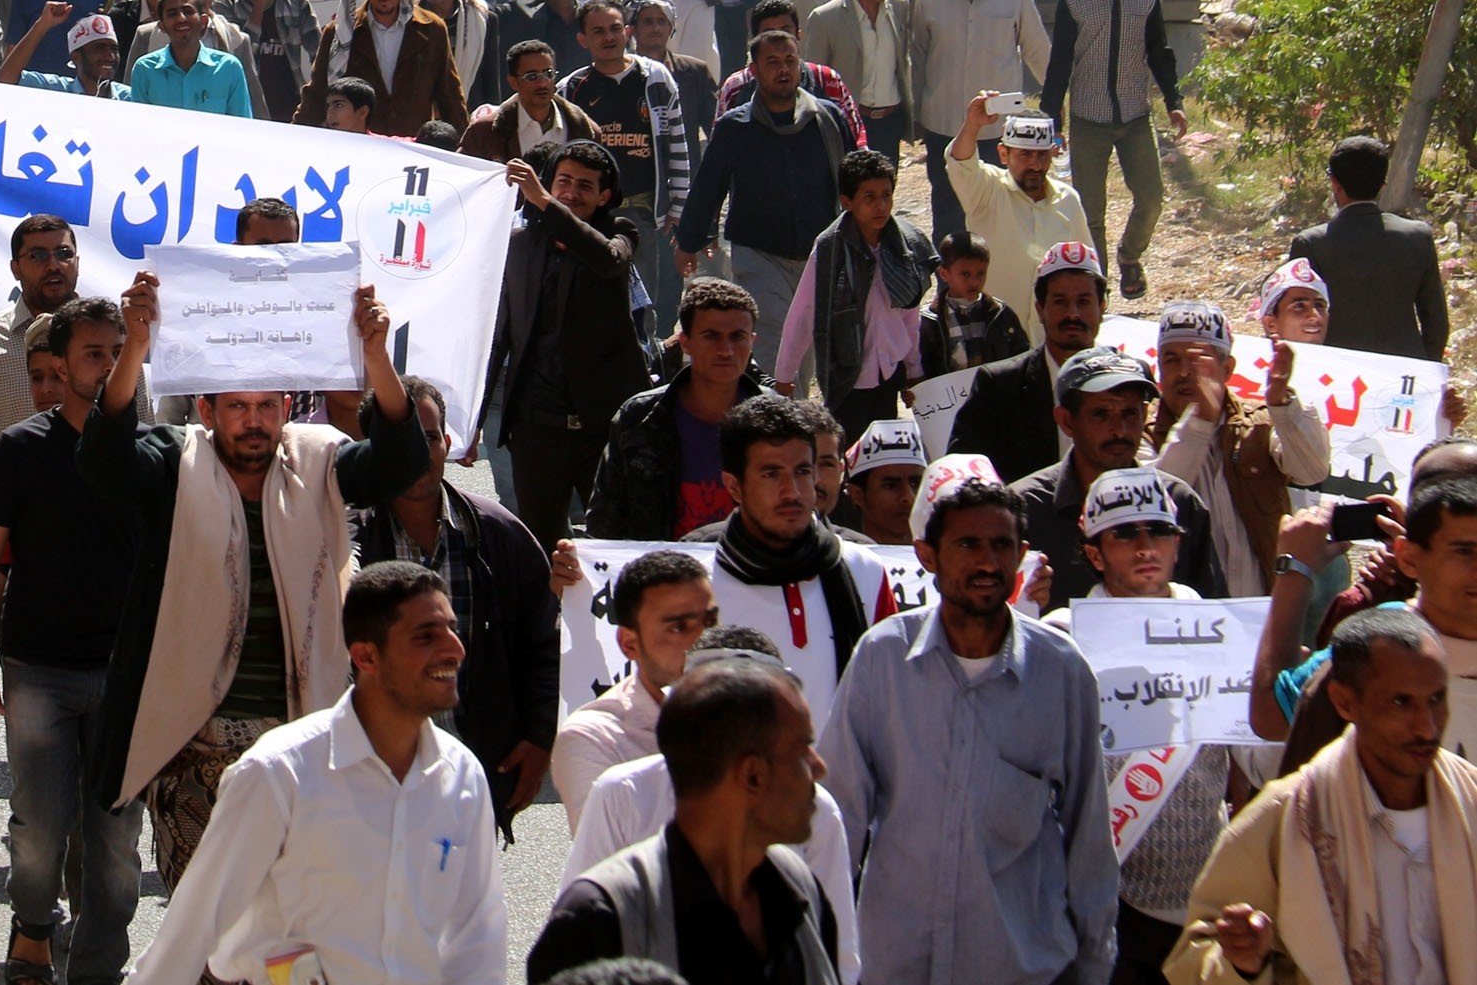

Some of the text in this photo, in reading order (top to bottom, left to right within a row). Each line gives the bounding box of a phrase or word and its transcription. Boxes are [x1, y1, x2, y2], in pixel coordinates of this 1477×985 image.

[601, 133, 649, 147] PERIENC
[403, 166, 429, 196] 11
[388, 199, 431, 216] فبراير
[248, 300, 302, 316] بالوطن
[205, 330, 264, 345] الدولة
[1145, 616, 1225, 644] كلنا
